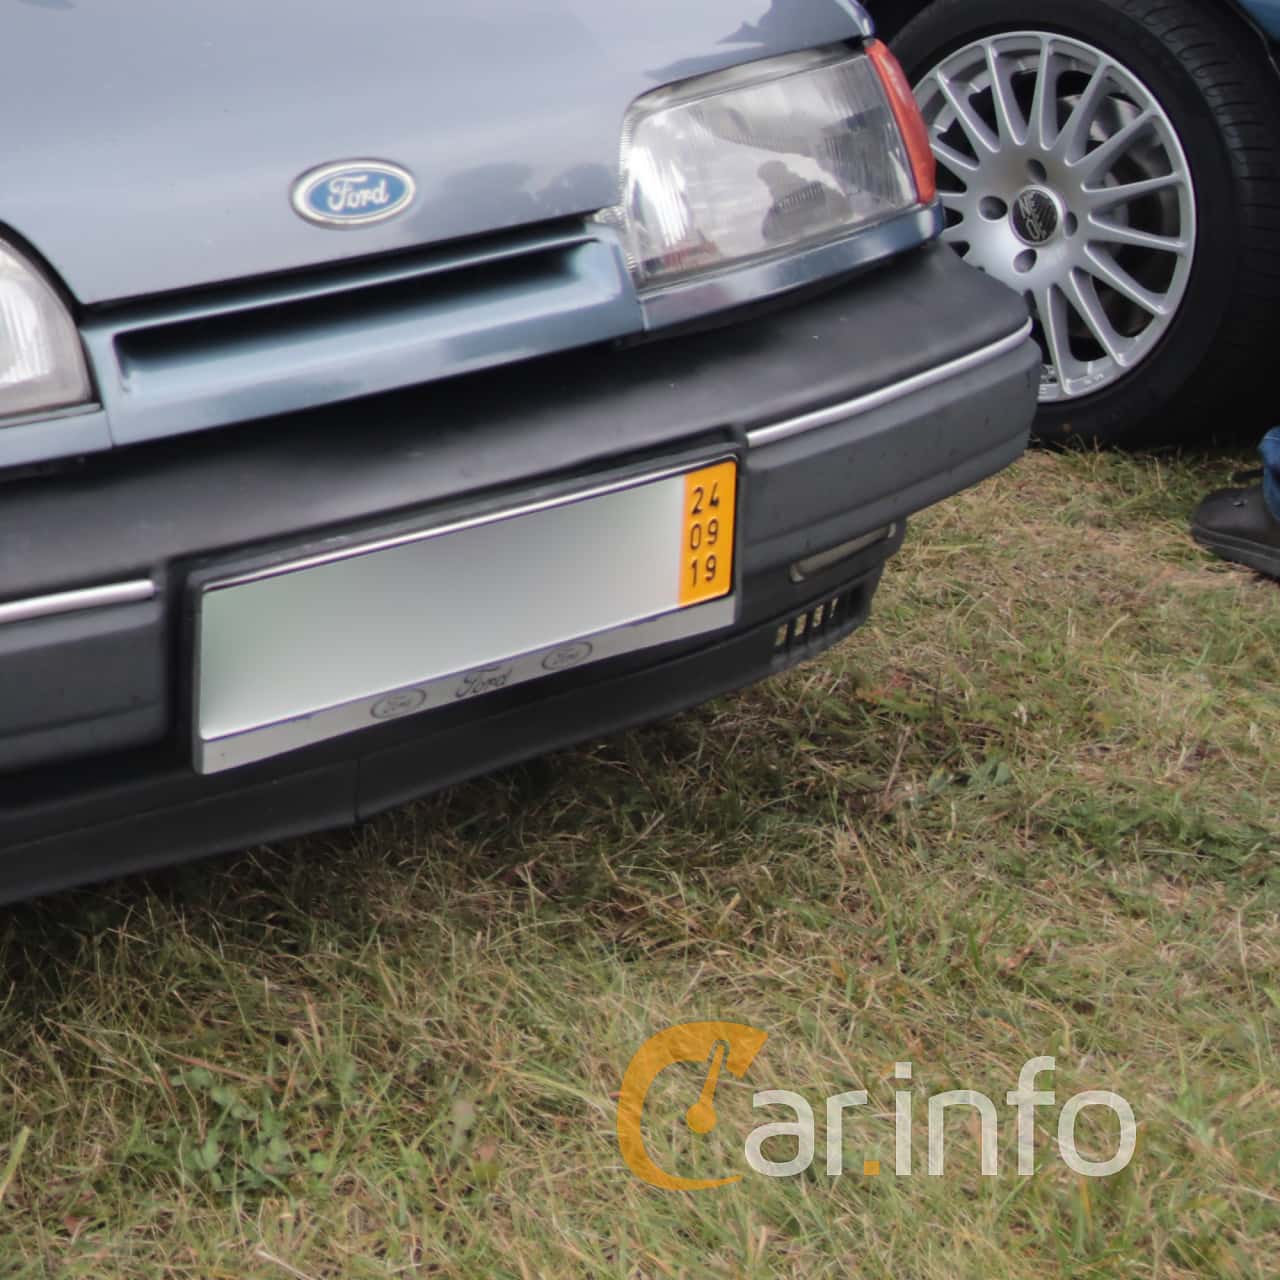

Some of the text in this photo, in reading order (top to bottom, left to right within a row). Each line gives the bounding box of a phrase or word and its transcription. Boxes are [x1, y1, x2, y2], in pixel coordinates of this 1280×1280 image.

[327, 175, 390, 211] Ford
[691, 482, 720, 514] 24
[689, 519, 719, 550] 09
[689, 554, 718, 587] 19
[455, 666, 513, 698] Ford
